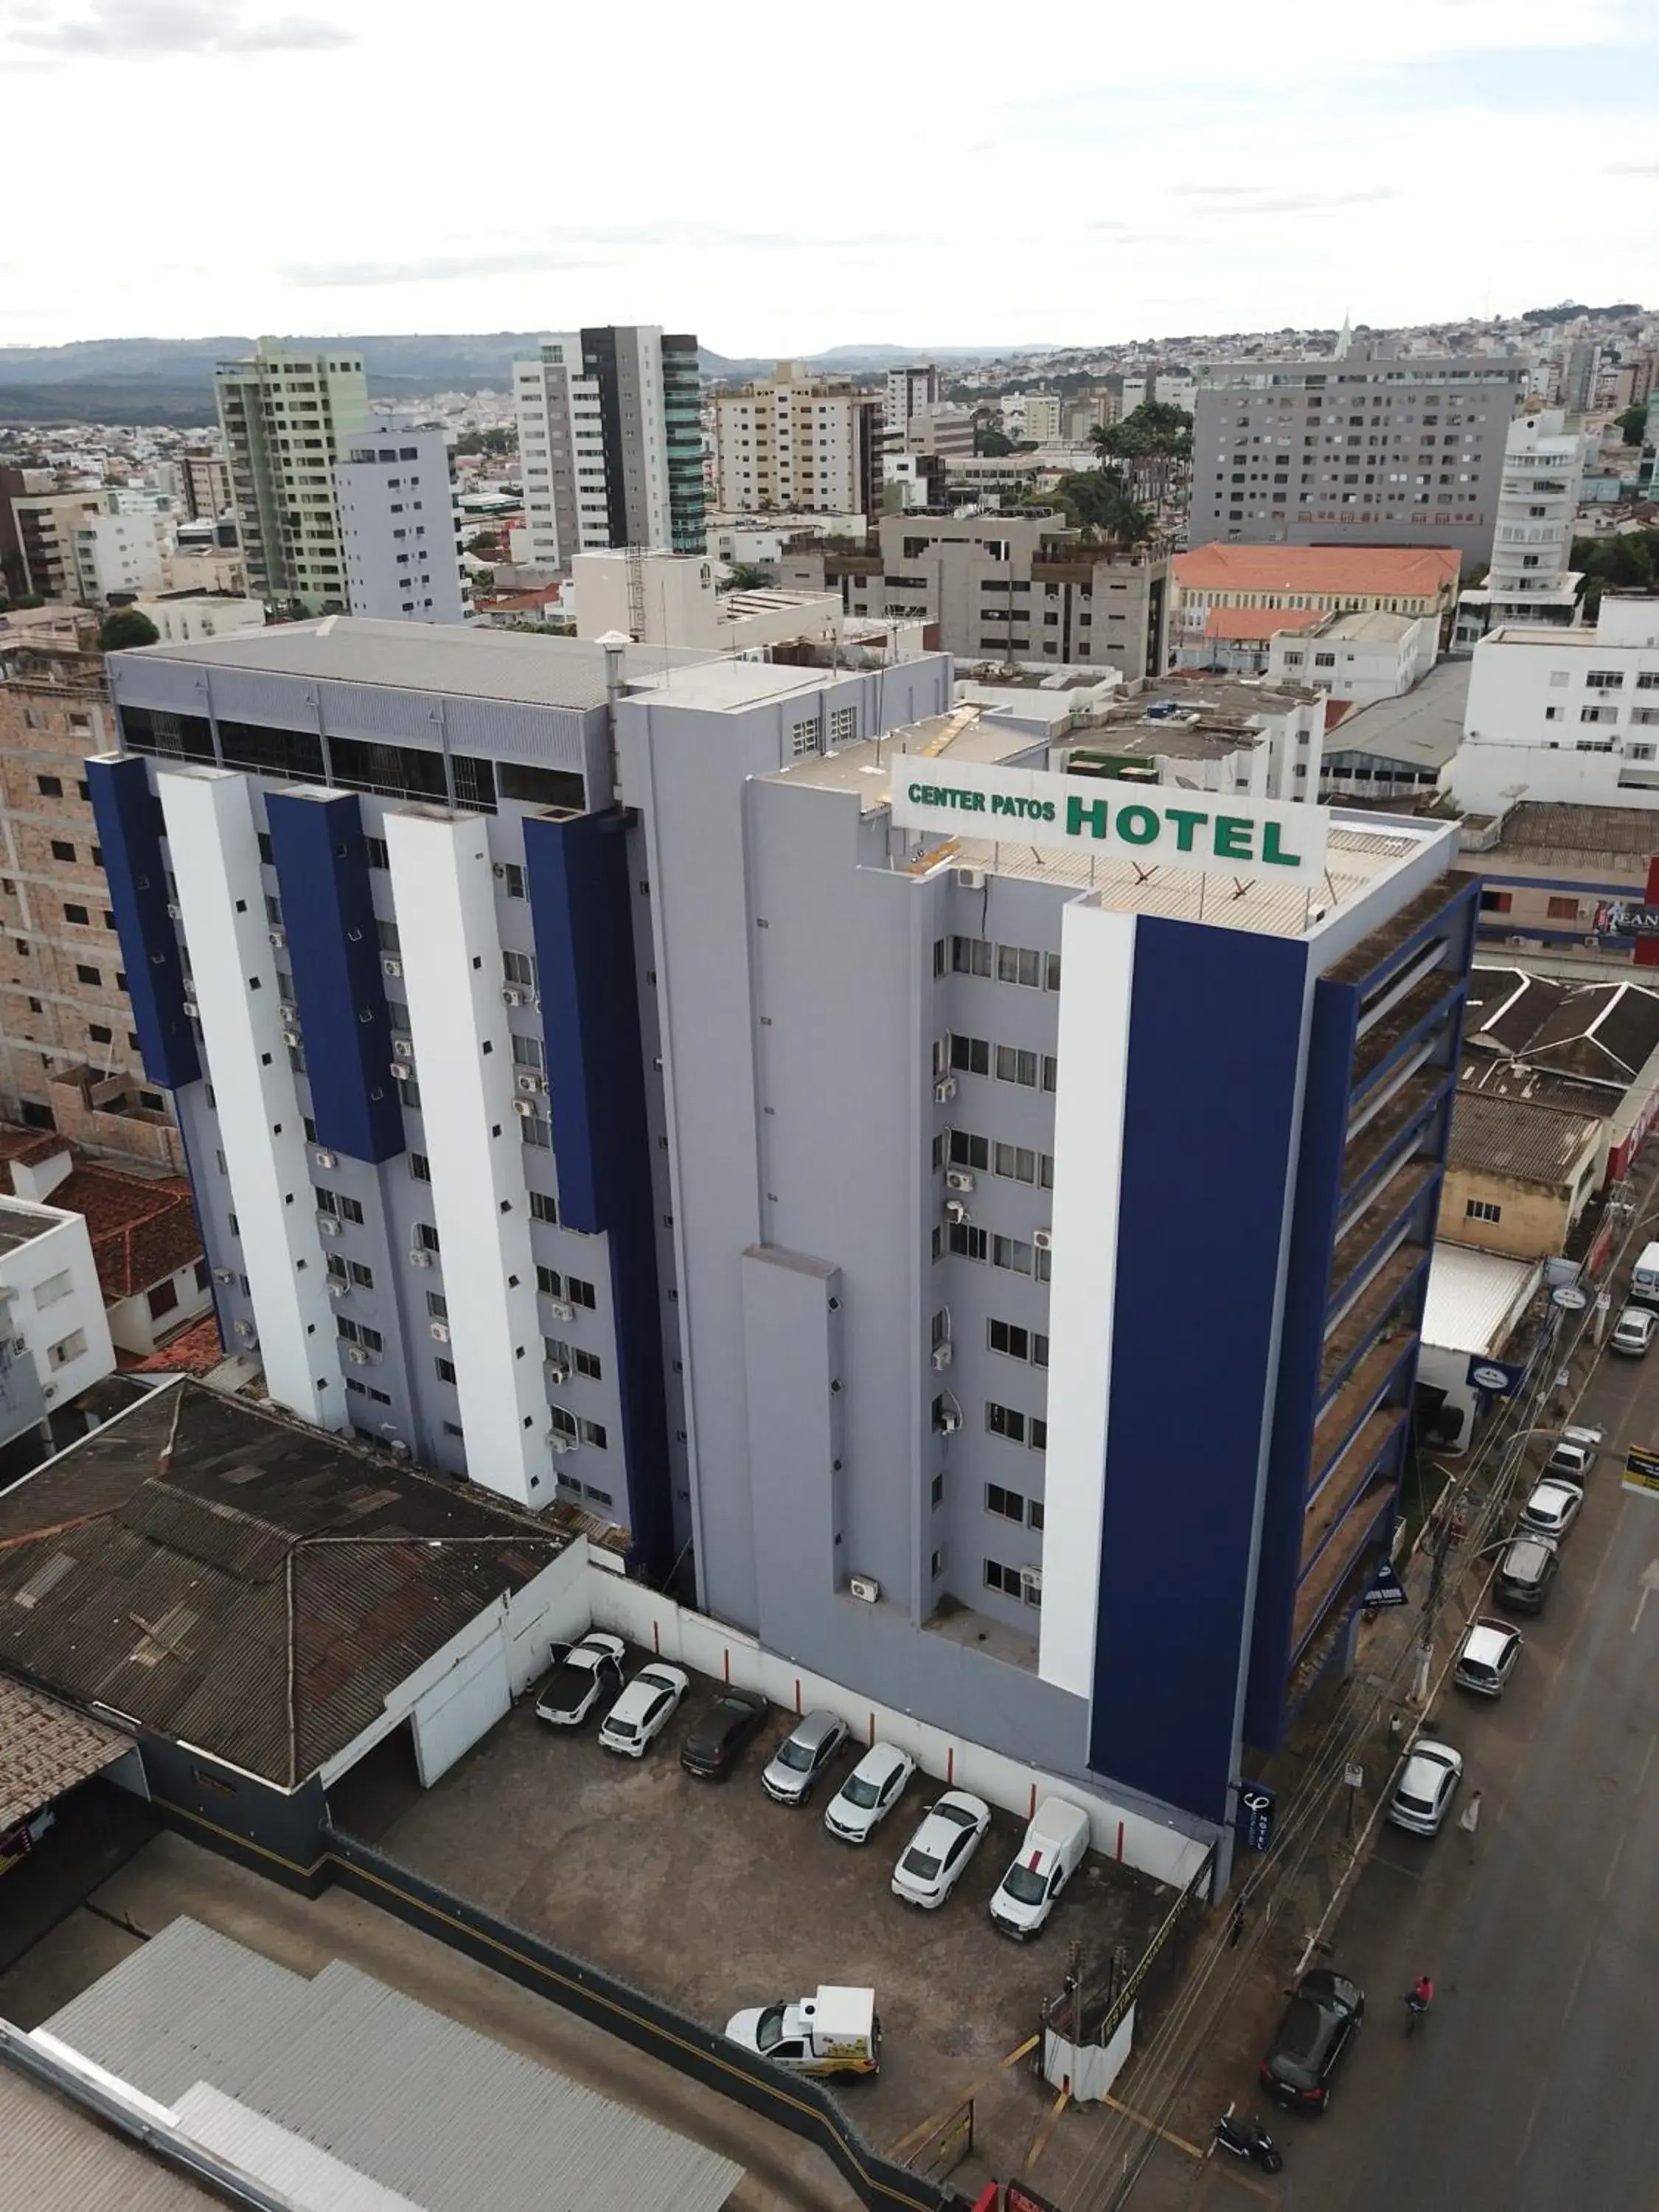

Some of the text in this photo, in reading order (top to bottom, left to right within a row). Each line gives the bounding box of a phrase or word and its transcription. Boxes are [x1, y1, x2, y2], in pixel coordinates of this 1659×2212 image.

[908, 784, 1301, 866] CENTER PATOS HOTEL
